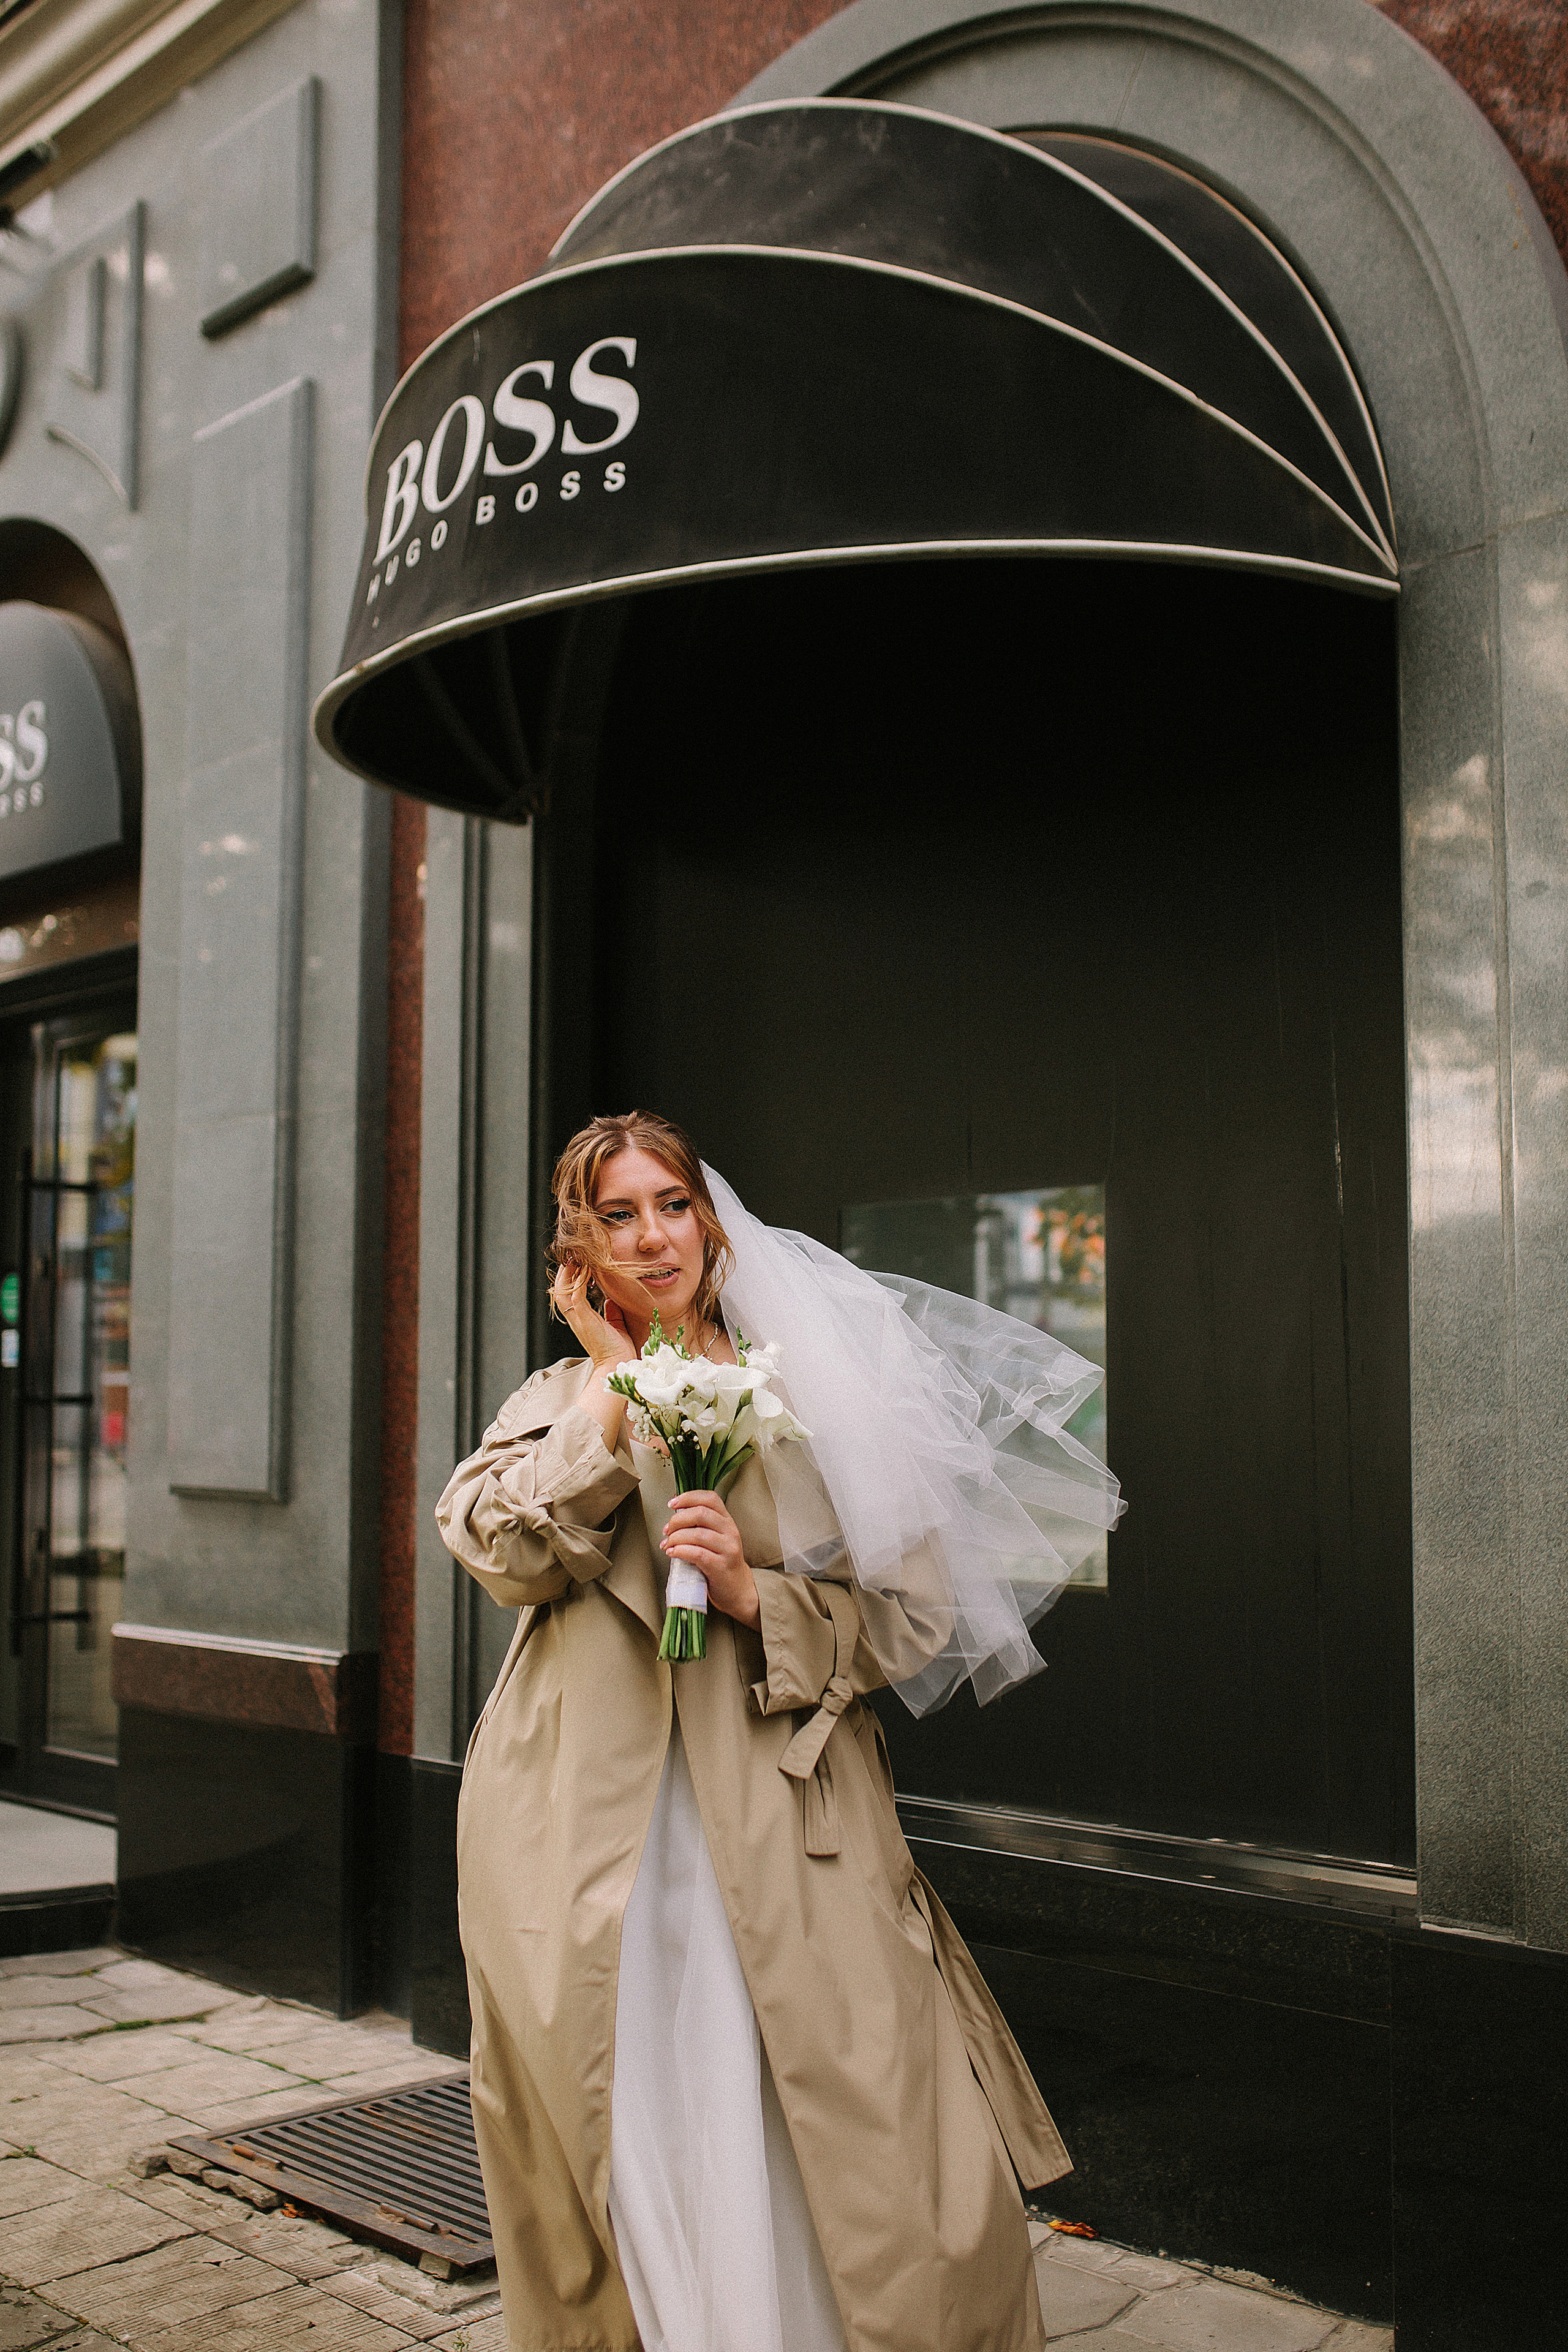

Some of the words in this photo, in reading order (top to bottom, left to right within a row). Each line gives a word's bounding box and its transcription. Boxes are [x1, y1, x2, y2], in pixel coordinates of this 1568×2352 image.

[366, 520, 448, 606] HUGO
[475, 462, 626, 525] BOSS
[372, 336, 639, 567] BOSS
